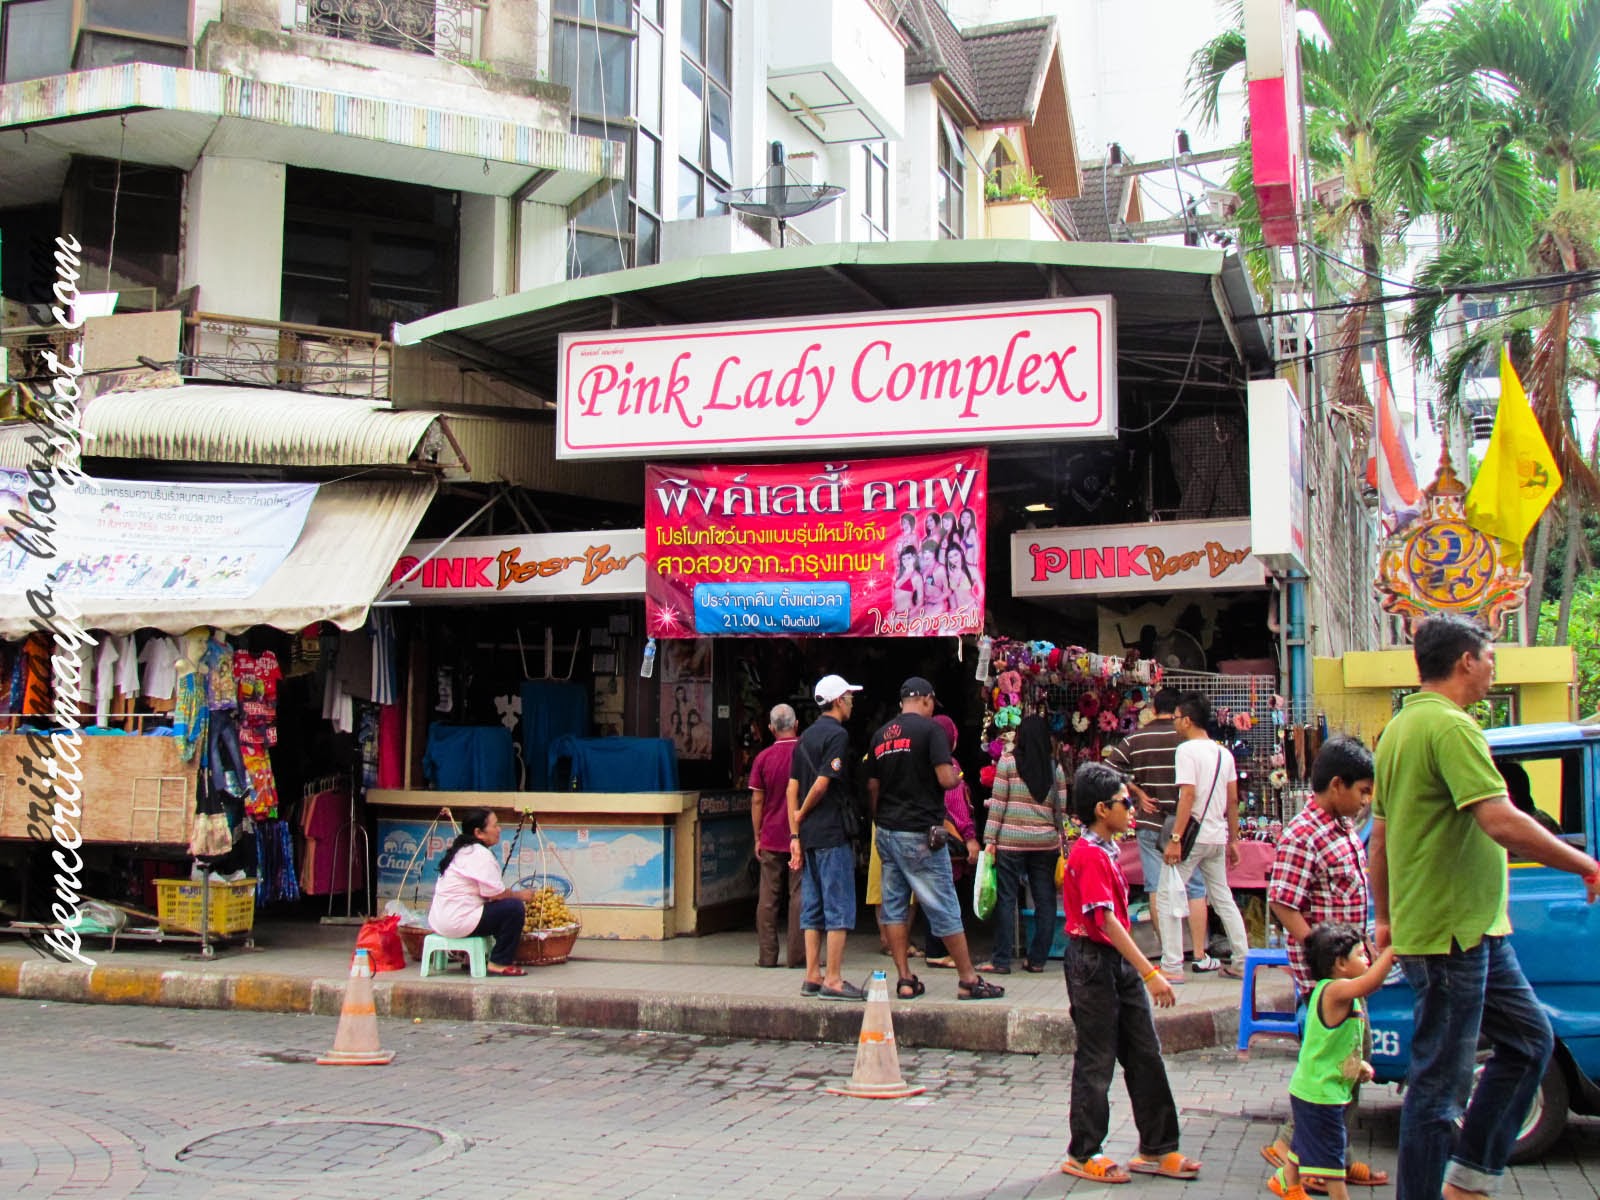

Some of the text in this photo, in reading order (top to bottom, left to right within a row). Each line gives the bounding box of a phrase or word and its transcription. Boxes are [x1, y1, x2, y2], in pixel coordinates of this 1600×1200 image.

[577, 330, 1088, 428] Pink Lady Complex
[861, 463, 979, 512] คาเฟ่
[656, 521, 886, 548] โปรโมทโชว์นางแบบรุ่นใหม่ใจถึง
[388, 544, 646, 591] PINK Beer Bar
[656, 552, 886, 579] สาวสวยจาก..กรุงเทพฯ
[1028, 541, 1252, 582] PINK Beer Bar
[701, 587, 842, 611] ประจำทุกคืน ตั้งแต่เวลา
[723, 613, 820, 627] 21.00 น. เป็นต้นไป
